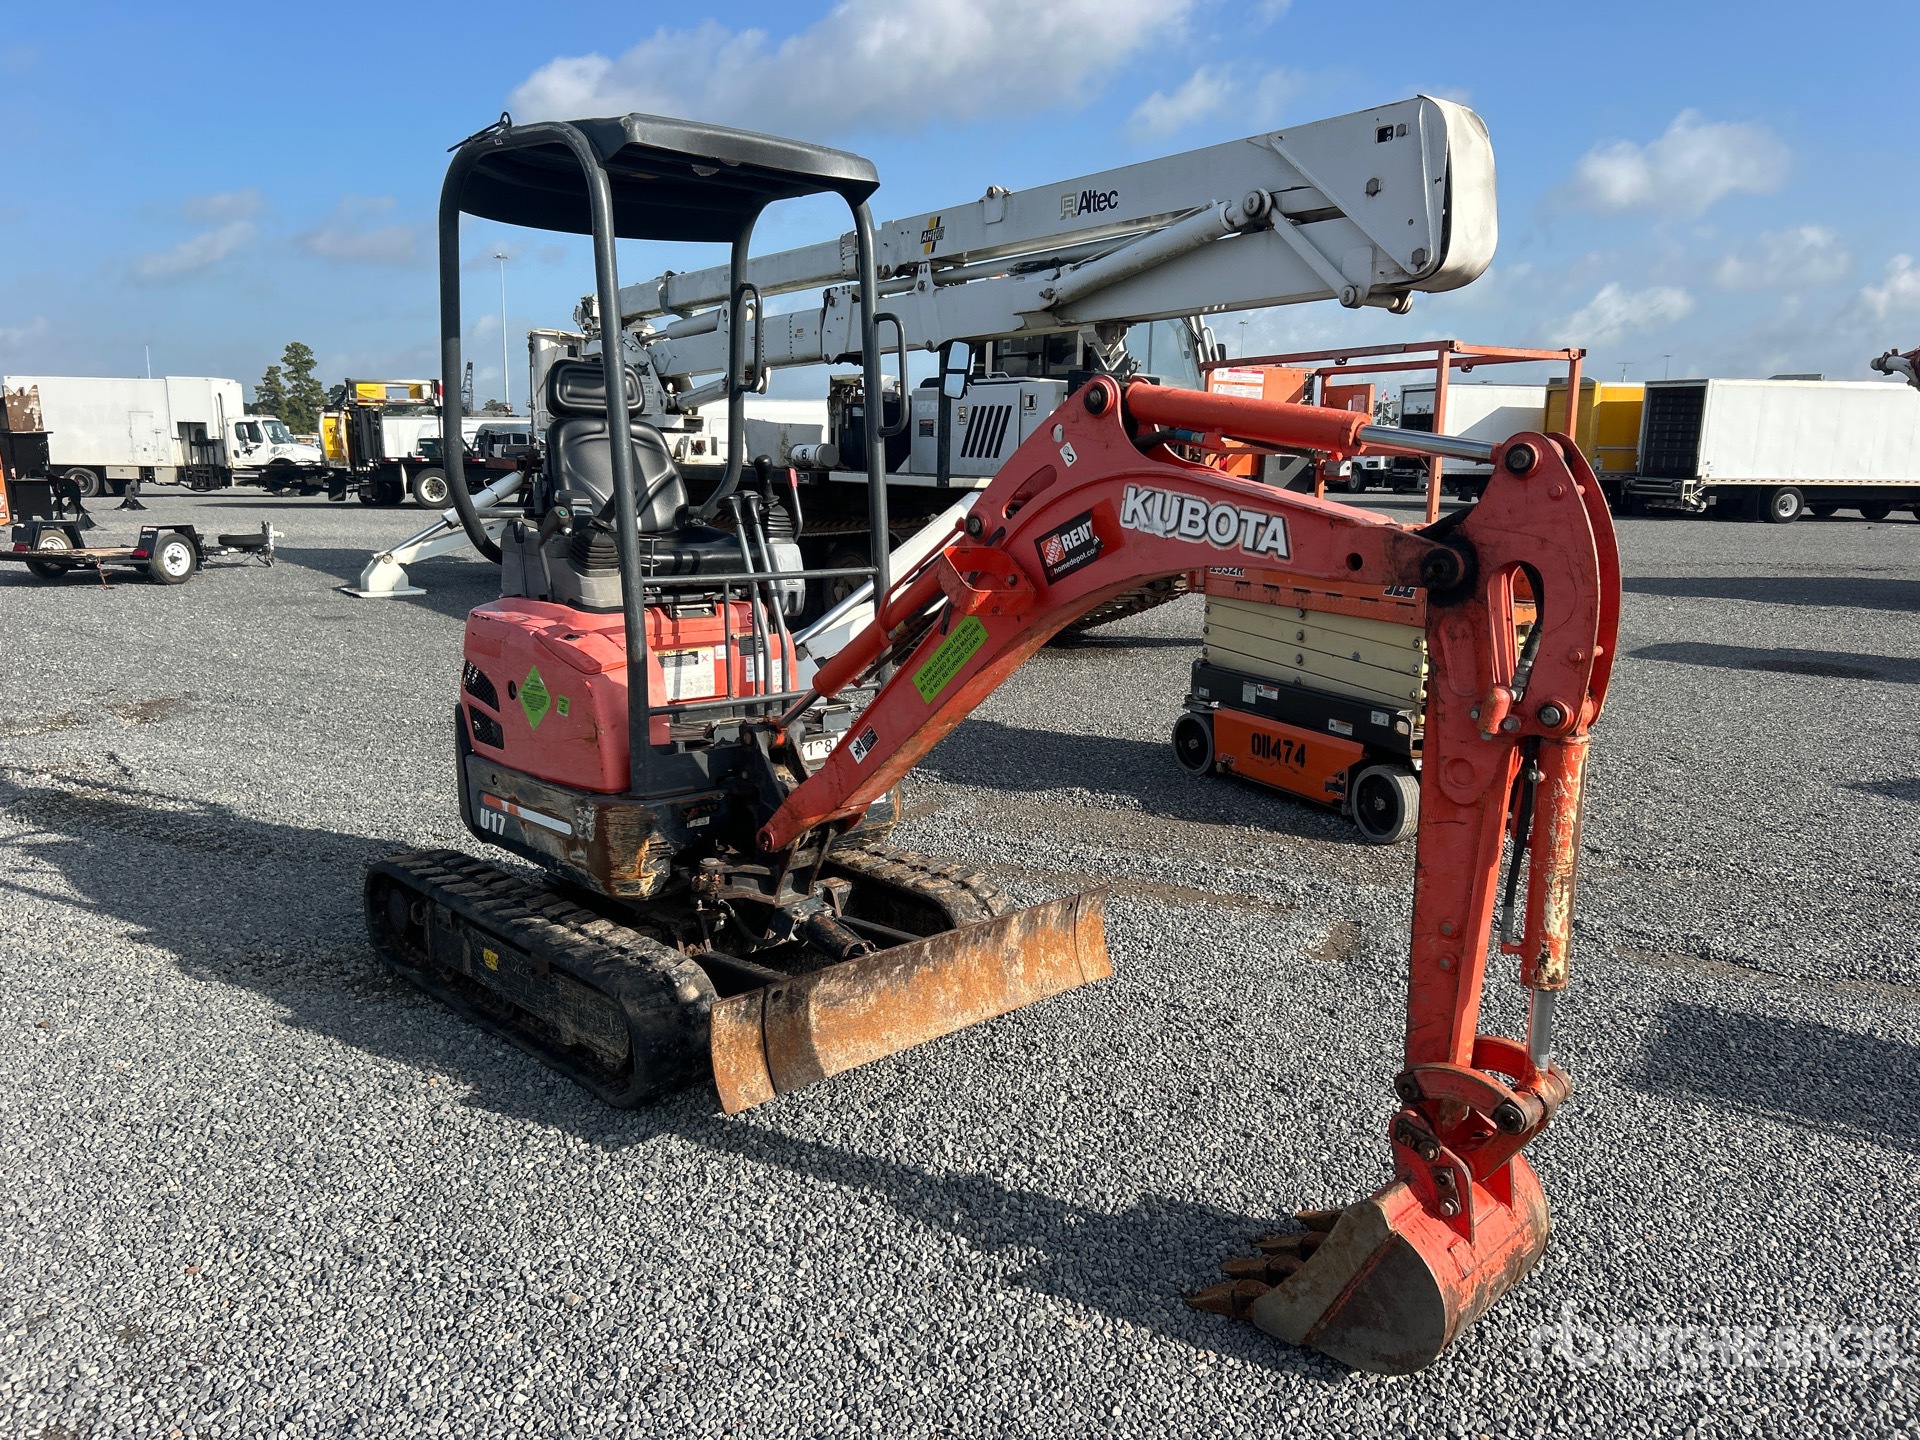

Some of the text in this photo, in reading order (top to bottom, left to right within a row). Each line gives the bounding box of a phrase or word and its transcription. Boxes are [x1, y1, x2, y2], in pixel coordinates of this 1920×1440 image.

[1077, 189, 1119, 216] Altec
[1122, 485, 1291, 560] KUBOTA
[920, 684, 928, 693] BE
[926, 661, 947, 686] CHARGED
[950, 645, 962, 659] THIS
[959, 623, 981, 648] MACHINE
[931, 642, 954, 668] CLEANING
[952, 632, 963, 644] FEE
[960, 622, 973, 635] WILL
[932, 677, 943, 690] NOT
[941, 652, 965, 679] RETURNED
[964, 635, 980, 654] CLEAN
[1251, 732, 1306, 768] 011474
[479, 807, 506, 836] U17
